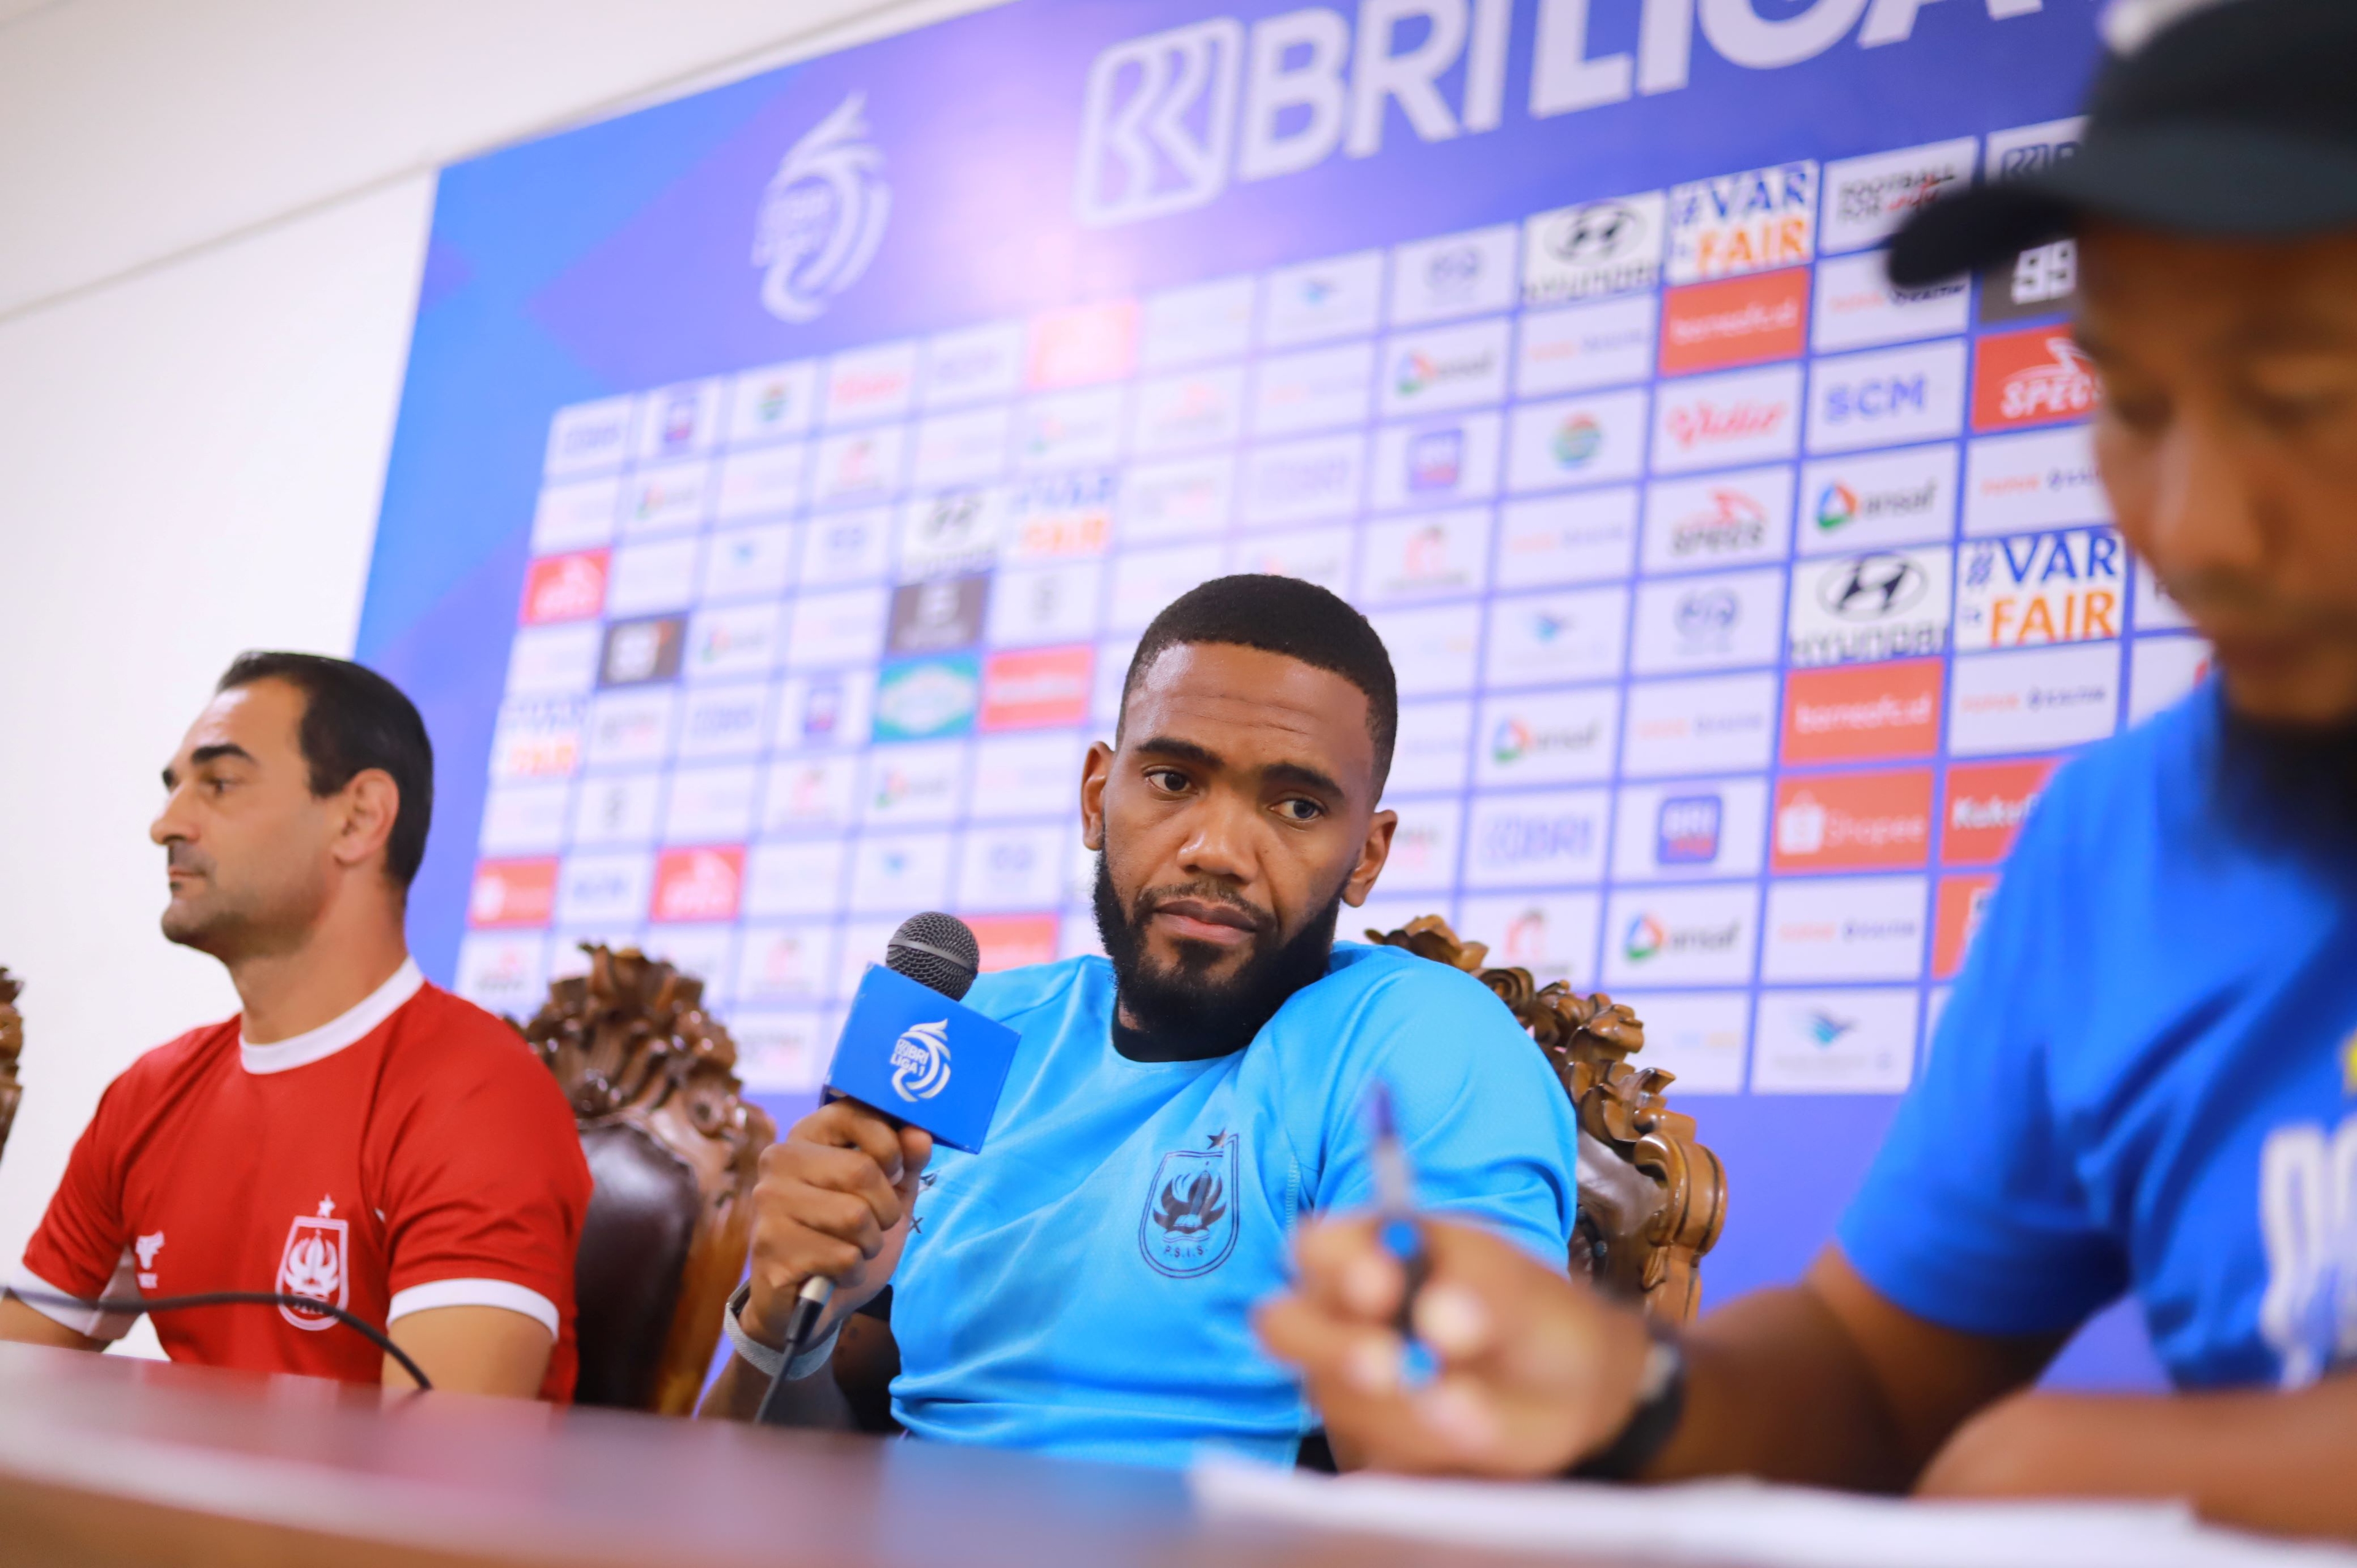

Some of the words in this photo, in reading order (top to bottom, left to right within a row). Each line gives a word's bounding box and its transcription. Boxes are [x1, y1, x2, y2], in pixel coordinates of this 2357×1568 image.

[1528, 0, 2044, 118] LI
[1697, 218, 1809, 277] FAIR
[1824, 374, 1927, 424] SCM
[1966, 529, 2118, 587] #VAR
[1989, 591, 2115, 648] FAIR
[1824, 808, 1926, 849] Shopee
[890, 1052, 918, 1074] LIGA
[908, 1043, 929, 1065] BRI
